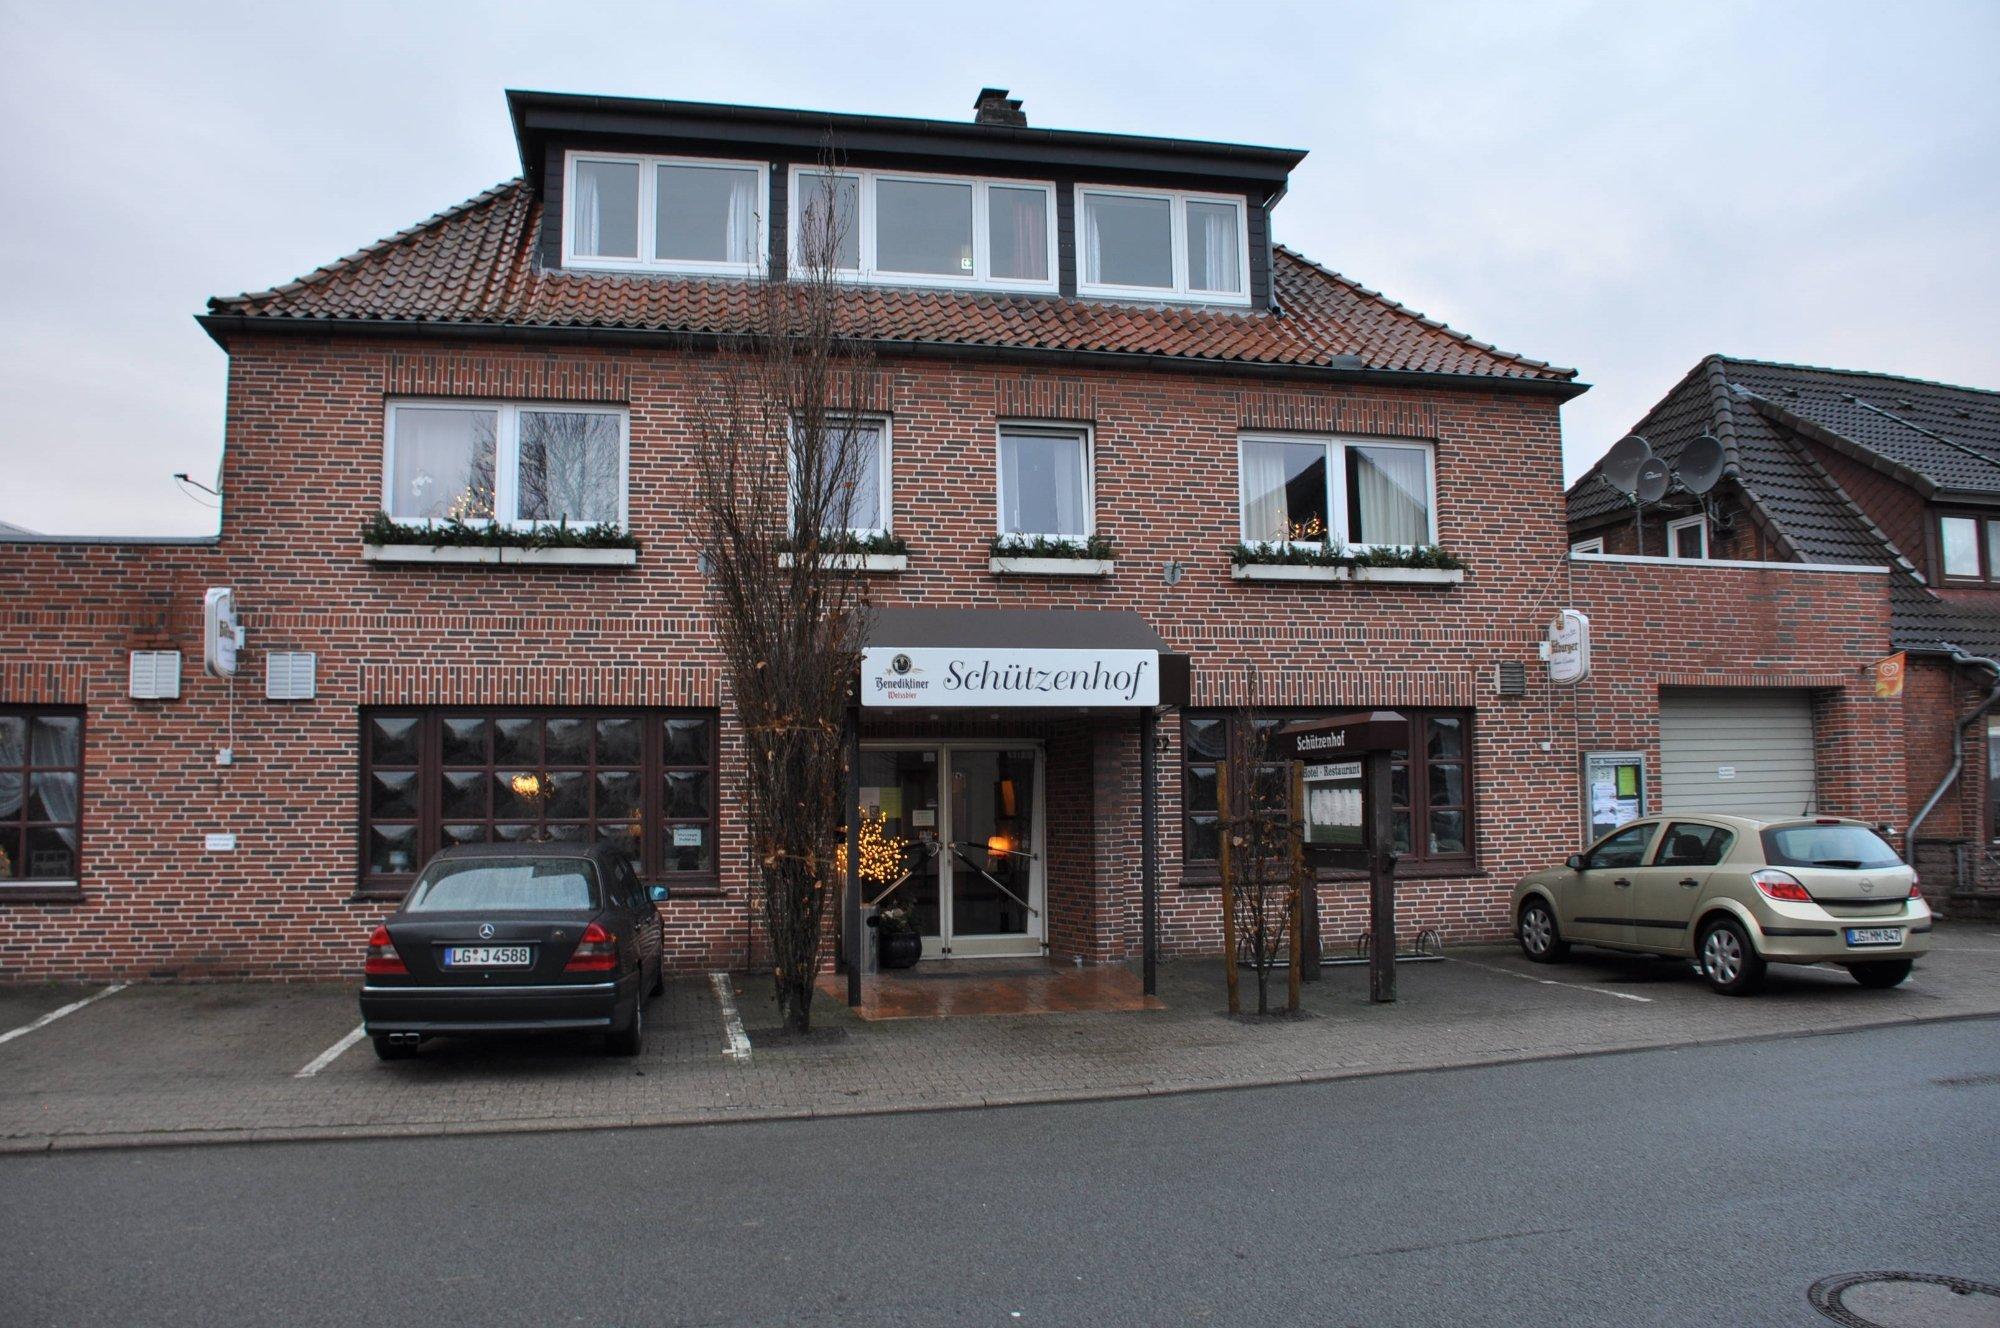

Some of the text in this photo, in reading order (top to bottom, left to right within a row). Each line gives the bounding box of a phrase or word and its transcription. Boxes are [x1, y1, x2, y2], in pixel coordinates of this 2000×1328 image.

[875, 677, 929, 691] Benediktiner
[943, 659, 1148, 701] Schützenhof
[1296, 730, 1346, 751] Schützenhof
[1323, 763, 1360, 777] Restaurant
[1853, 929, 1865, 942] LG
[452, 948, 528, 963] LG J 4588
